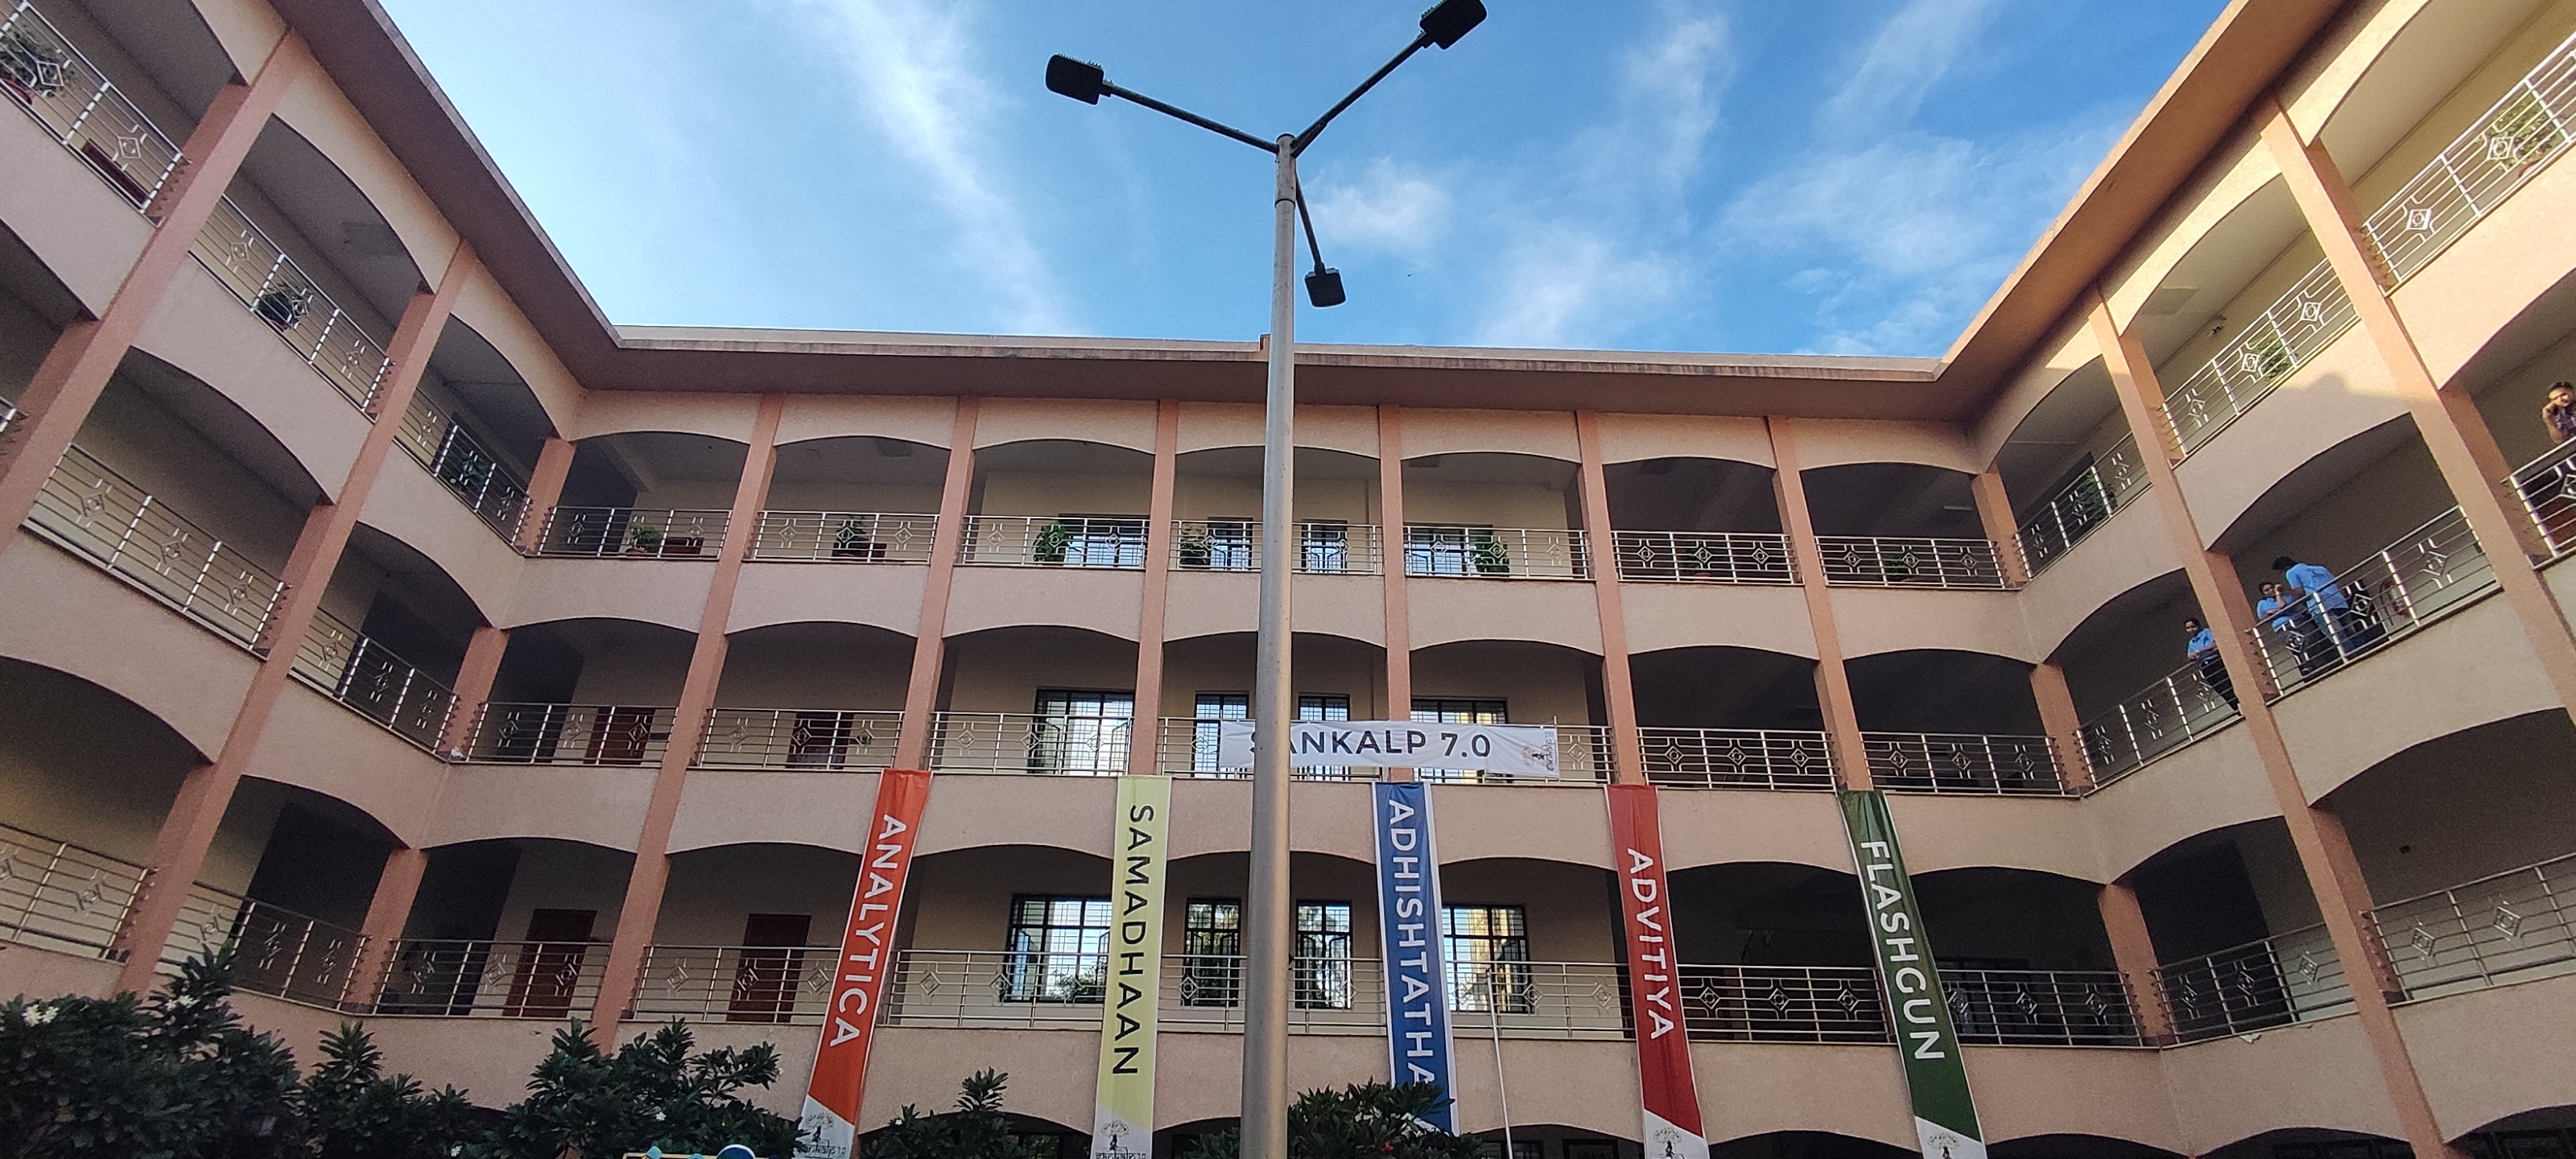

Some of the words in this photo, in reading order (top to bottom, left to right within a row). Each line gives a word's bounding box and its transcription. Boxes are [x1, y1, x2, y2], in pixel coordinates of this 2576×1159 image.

[1250, 731, 1426, 754] NKALP
[1441, 732, 1490, 757] 7.0
[830, 815, 906, 1046] ANALYTICA
[1113, 805, 1154, 1074] SAMADHAAN
[1628, 848, 1674, 1039] ADVITIYA
[1860, 841, 1945, 1059] FLASHGUN
